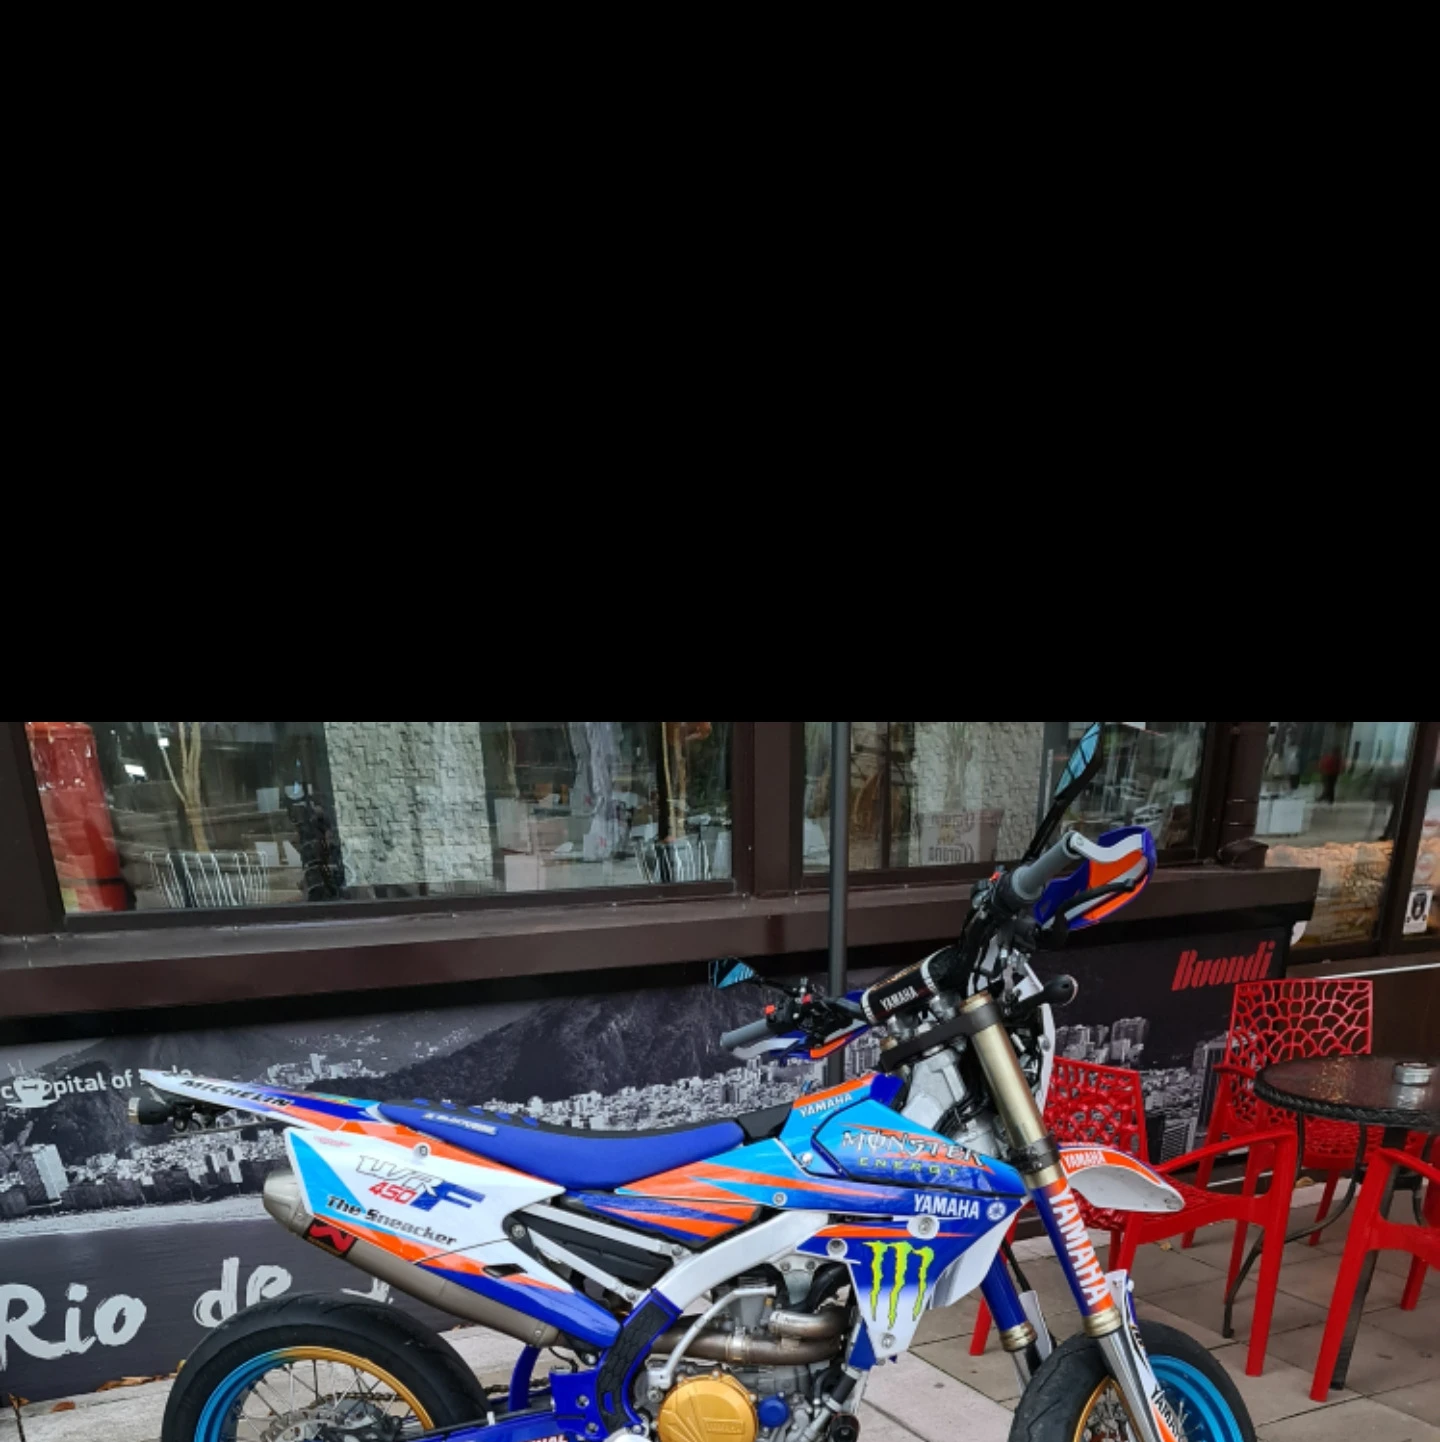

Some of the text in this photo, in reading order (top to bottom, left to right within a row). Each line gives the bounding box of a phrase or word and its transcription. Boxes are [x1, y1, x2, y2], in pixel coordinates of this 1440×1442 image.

[1171, 940, 1276, 991] Buondi
[880, 986, 919, 1011] YAMAHA
[111, 1071, 133, 1090] of
[181, 1080, 294, 1107] MICHELIN
[800, 1094, 853, 1118] YAMAHA
[858, 1157, 959, 1177] ENERGY
[1064, 1151, 1106, 1169] YAMAHA
[369, 1181, 418, 1205] 450
[914, 1194, 979, 1219] YAMAHA
[327, 1196, 362, 1216] The
[365, 1209, 458, 1246] Sneacker
[1049, 1185, 1111, 1307] YAMAHA
[0, 1282, 147, 1372] Rio
